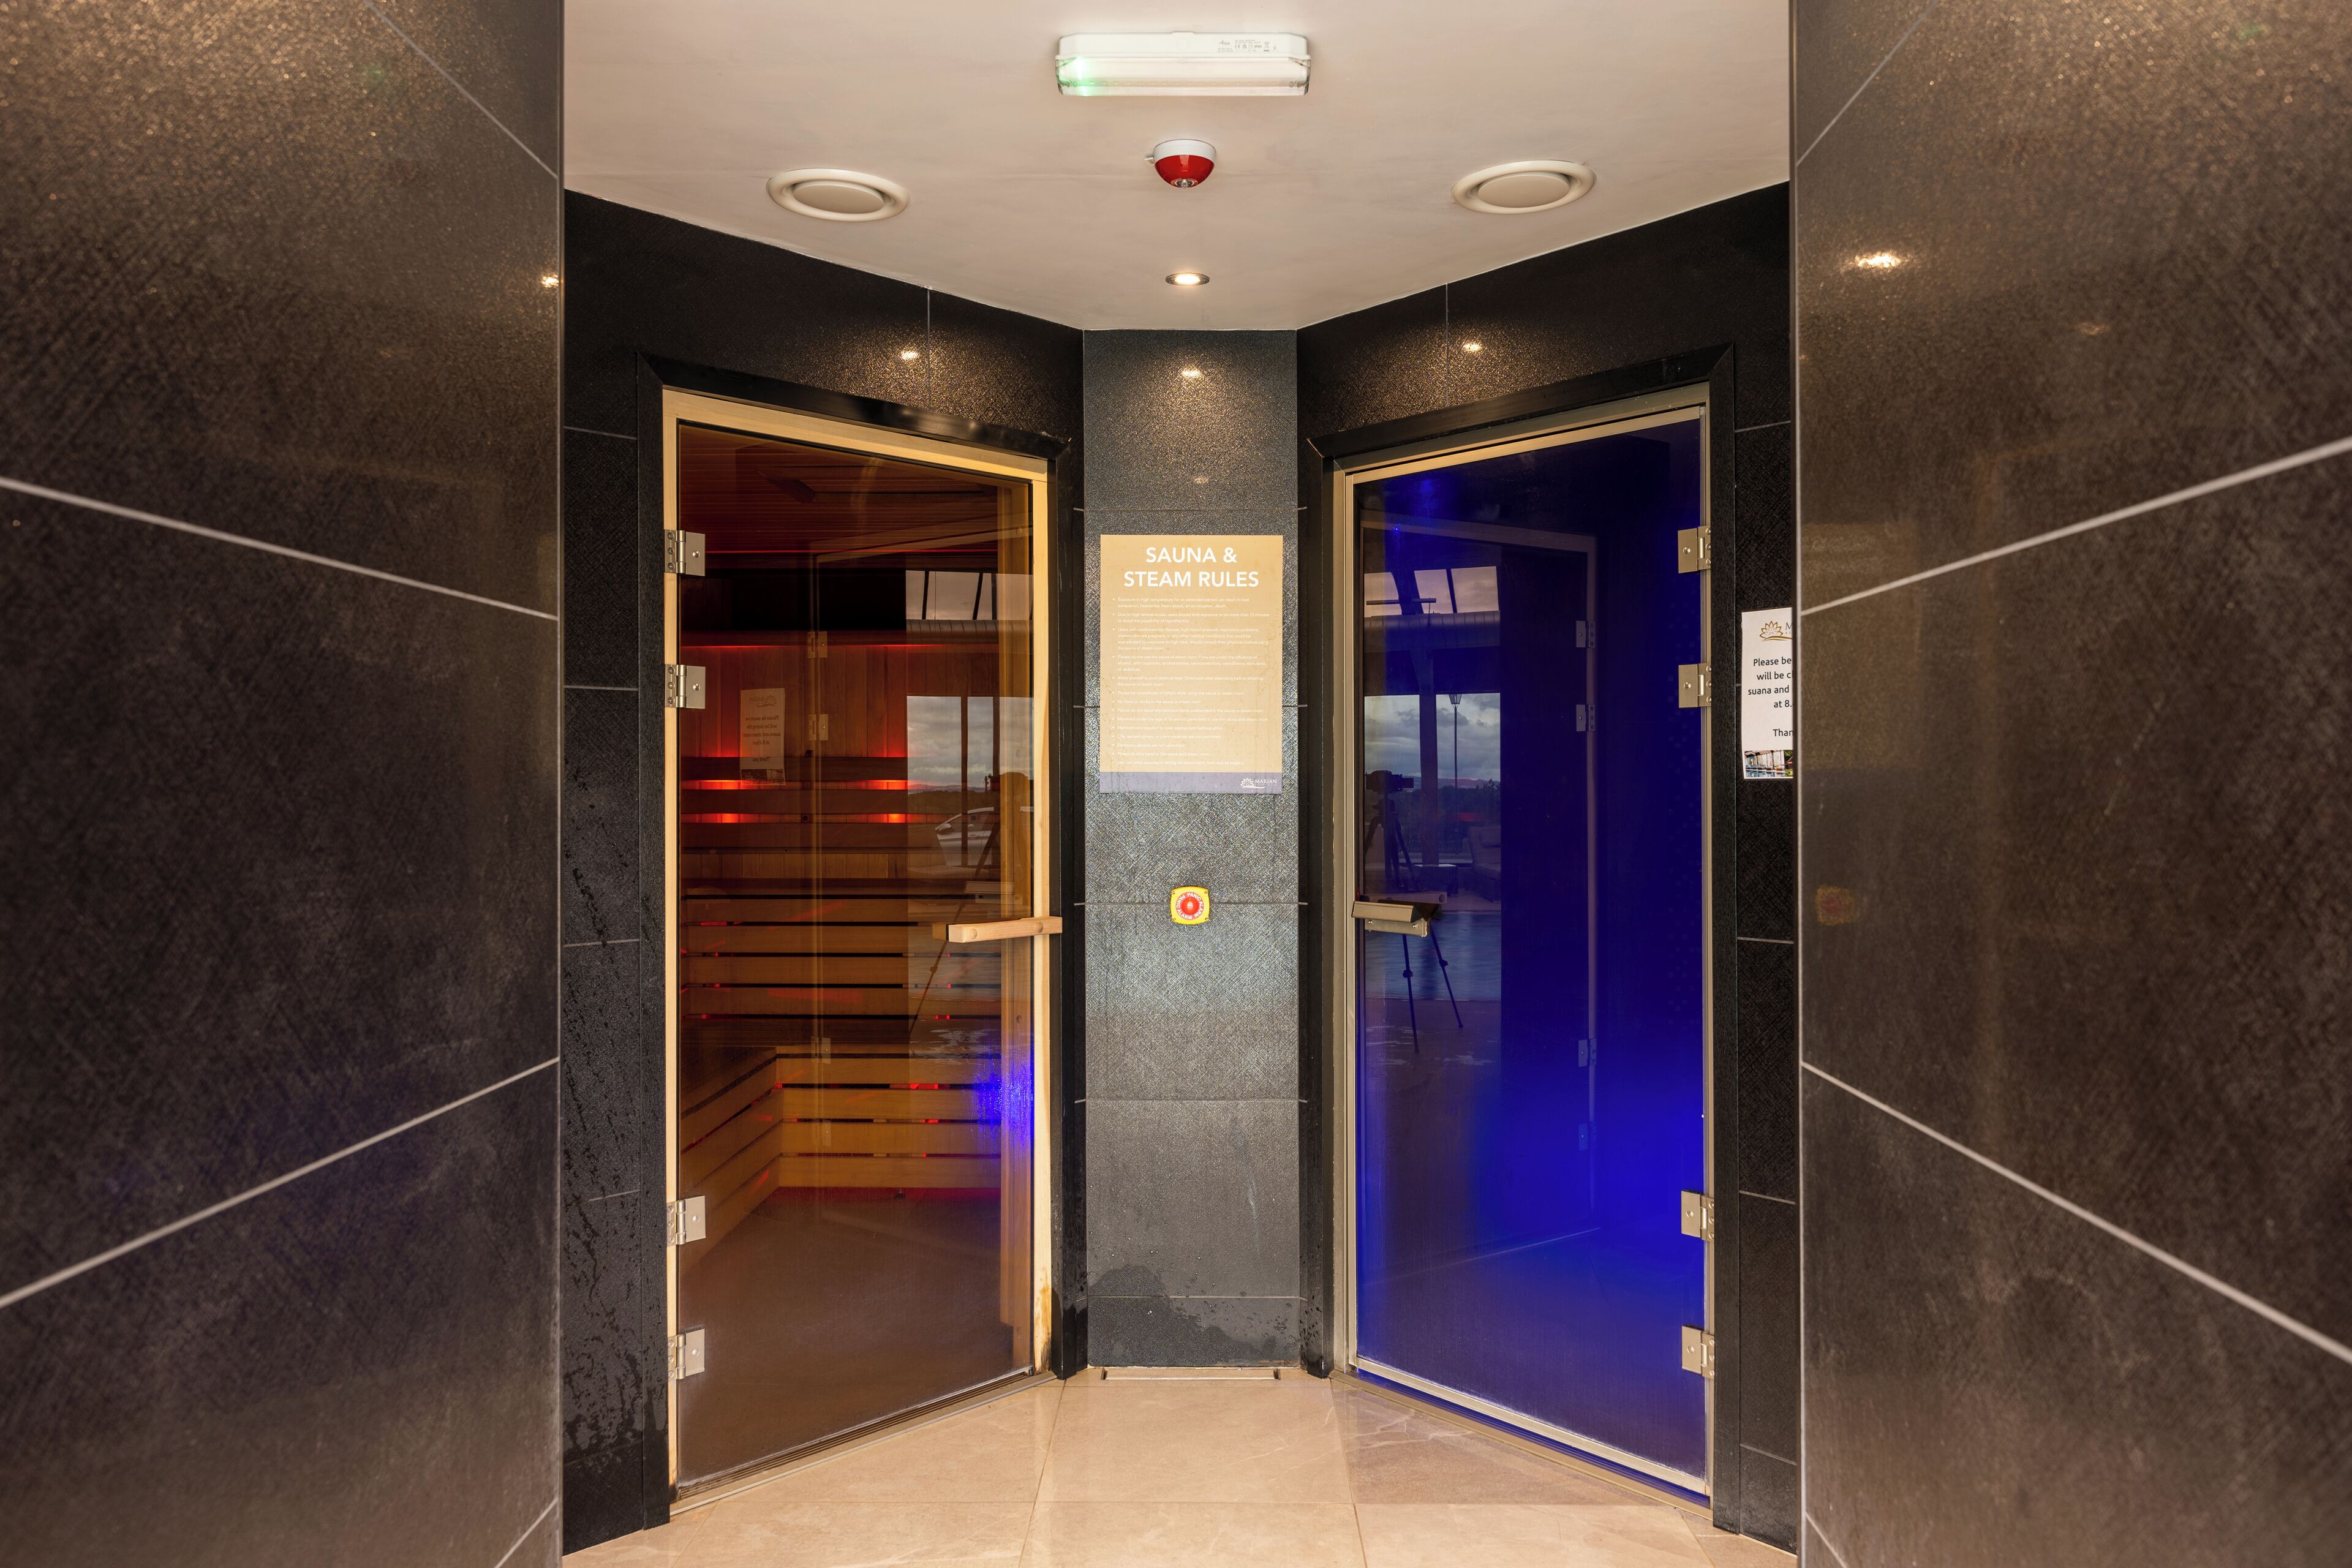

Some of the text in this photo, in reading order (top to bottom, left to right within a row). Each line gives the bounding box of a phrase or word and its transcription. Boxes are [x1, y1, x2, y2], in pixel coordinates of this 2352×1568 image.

[1146, 547, 1237, 563] SAUNA &
[1124, 571, 1259, 587] STEAM RULES
[1757, 671, 1772, 680] will
[1774, 685, 1789, 693] and
[1176, 894, 1193, 919] PANIC ALARM
[1187, 892, 1204, 918] PANIC ALARM
